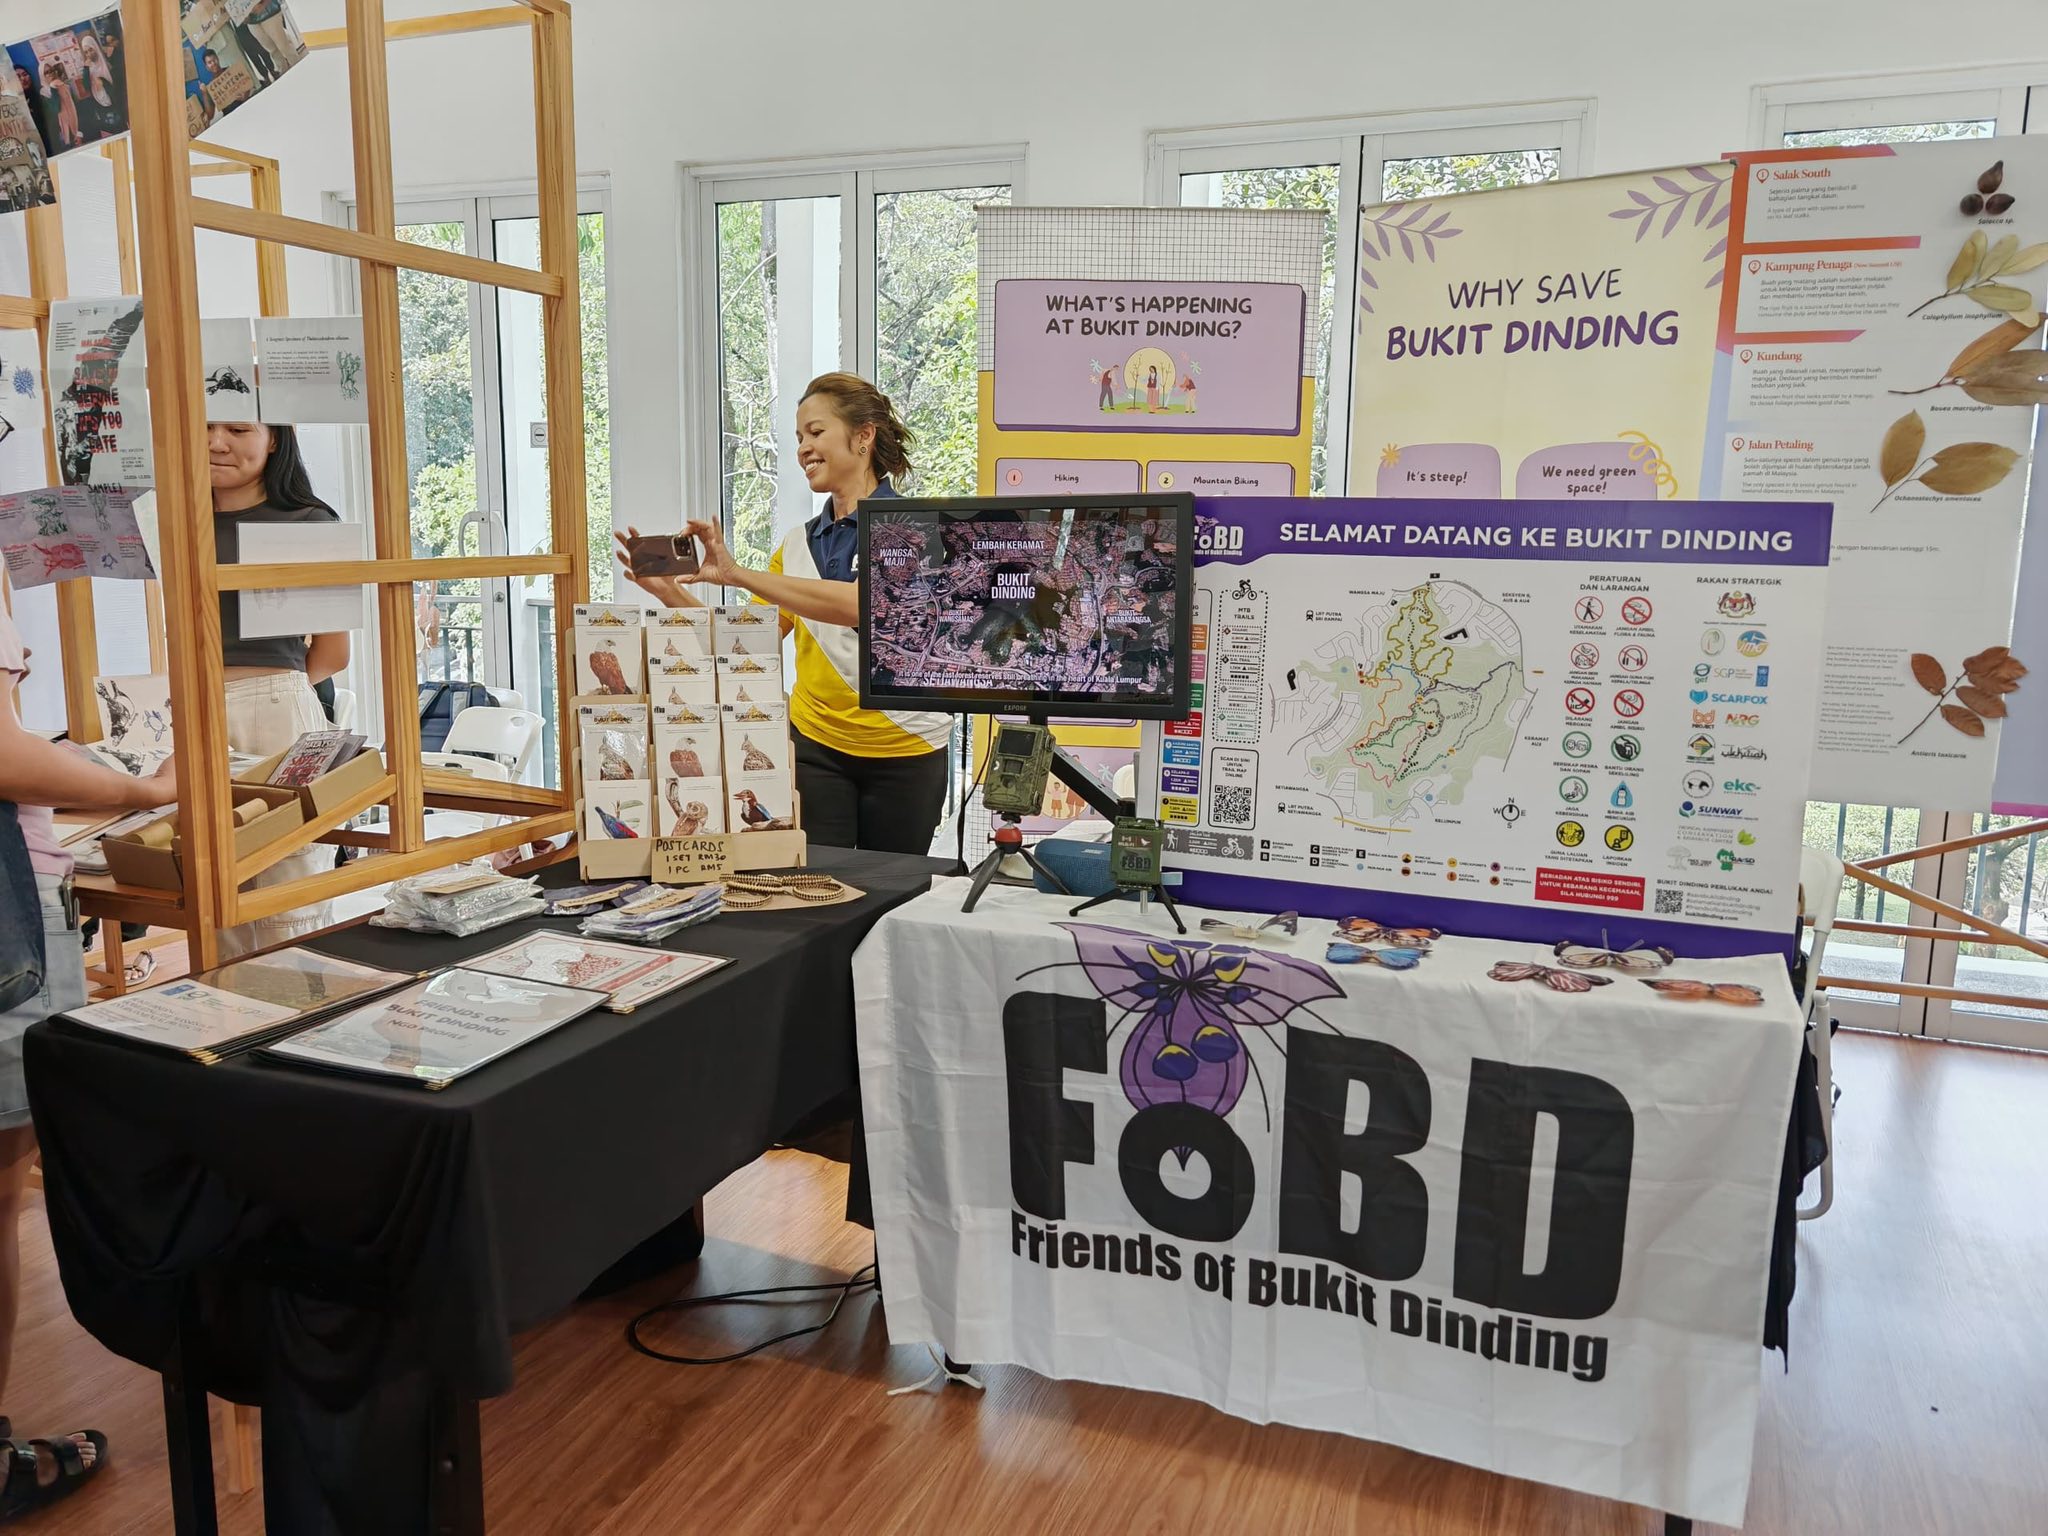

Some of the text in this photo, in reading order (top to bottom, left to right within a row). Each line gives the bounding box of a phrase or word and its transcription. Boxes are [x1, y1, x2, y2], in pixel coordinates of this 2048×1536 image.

[1773, 168, 1831, 181] Salak South
[1765, 261, 1815, 273] Kampung
[1817, 260, 1852, 271] Penaga
[1449, 268, 1622, 309] WHY SAVE
[1046, 295, 1252, 315] WHAT'S HAPPENING
[1046, 318, 1242, 339] AT BUKIT DINDING?
[1387, 310, 1679, 360] BUKIT DINDING
[1757, 351, 1802, 362] Kundang
[100, 411, 122, 429] TOO
[1748, 440, 1814, 451] Jalan Petaling
[1406, 471, 1468, 484] It's steep!
[1542, 465, 1637, 480] We need green
[1054, 474, 1079, 484] Hiking
[1163, 477, 1169, 485] 2
[1193, 475, 1259, 487] Mountain Biking
[1567, 482, 1607, 496] space!
[1279, 523, 1794, 551] SELAMAT DATANG KE BUKIT DINDING
[973, 540, 1044, 550] LEMBAH KERAMAT
[880, 548, 912, 558] WANGSA
[884, 557, 906, 567] MAJU
[997, 574, 1030, 586] BUKIT
[1589, 575, 1642, 583] PERATURAN
[1731, 578, 1782, 586] STRATEGIK
[991, 586, 1035, 600] DINDING
[1714, 667, 1735, 678] SGP
[1068, 675, 1085, 683] heart
[1086, 675, 1095, 683] of
[1116, 677, 1142, 685] Lumpur
[1712, 693, 1768, 704] SCARFOX
[1698, 805, 1743, 816] SUNWAY
[656, 839, 724, 852] POSTCARDS
[673, 854, 691, 862] SET
[698, 854, 727, 862] RM30
[675, 866, 690, 874] PC
[700, 863, 723, 872] RM5
[1540, 880, 1561, 888] UNTUK
[1562, 883, 1597, 891] SEBARANG
[1591, 877, 1612, 885] RISIKO
[1679, 881, 1709, 889] DINDING
[1710, 883, 1748, 893] PERLUKAN
[1575, 892, 1605, 900] HUBUNGI
[415, 1000, 484, 1019] FRIENDS
[385, 1003, 511, 1036] BUKIT DINDING
[388, 1019, 469, 1040] NGO PROFILE
[1002, 990, 1635, 1321] FoBD
[1010, 1210, 1609, 1383] Friends of Bukit Dinding
